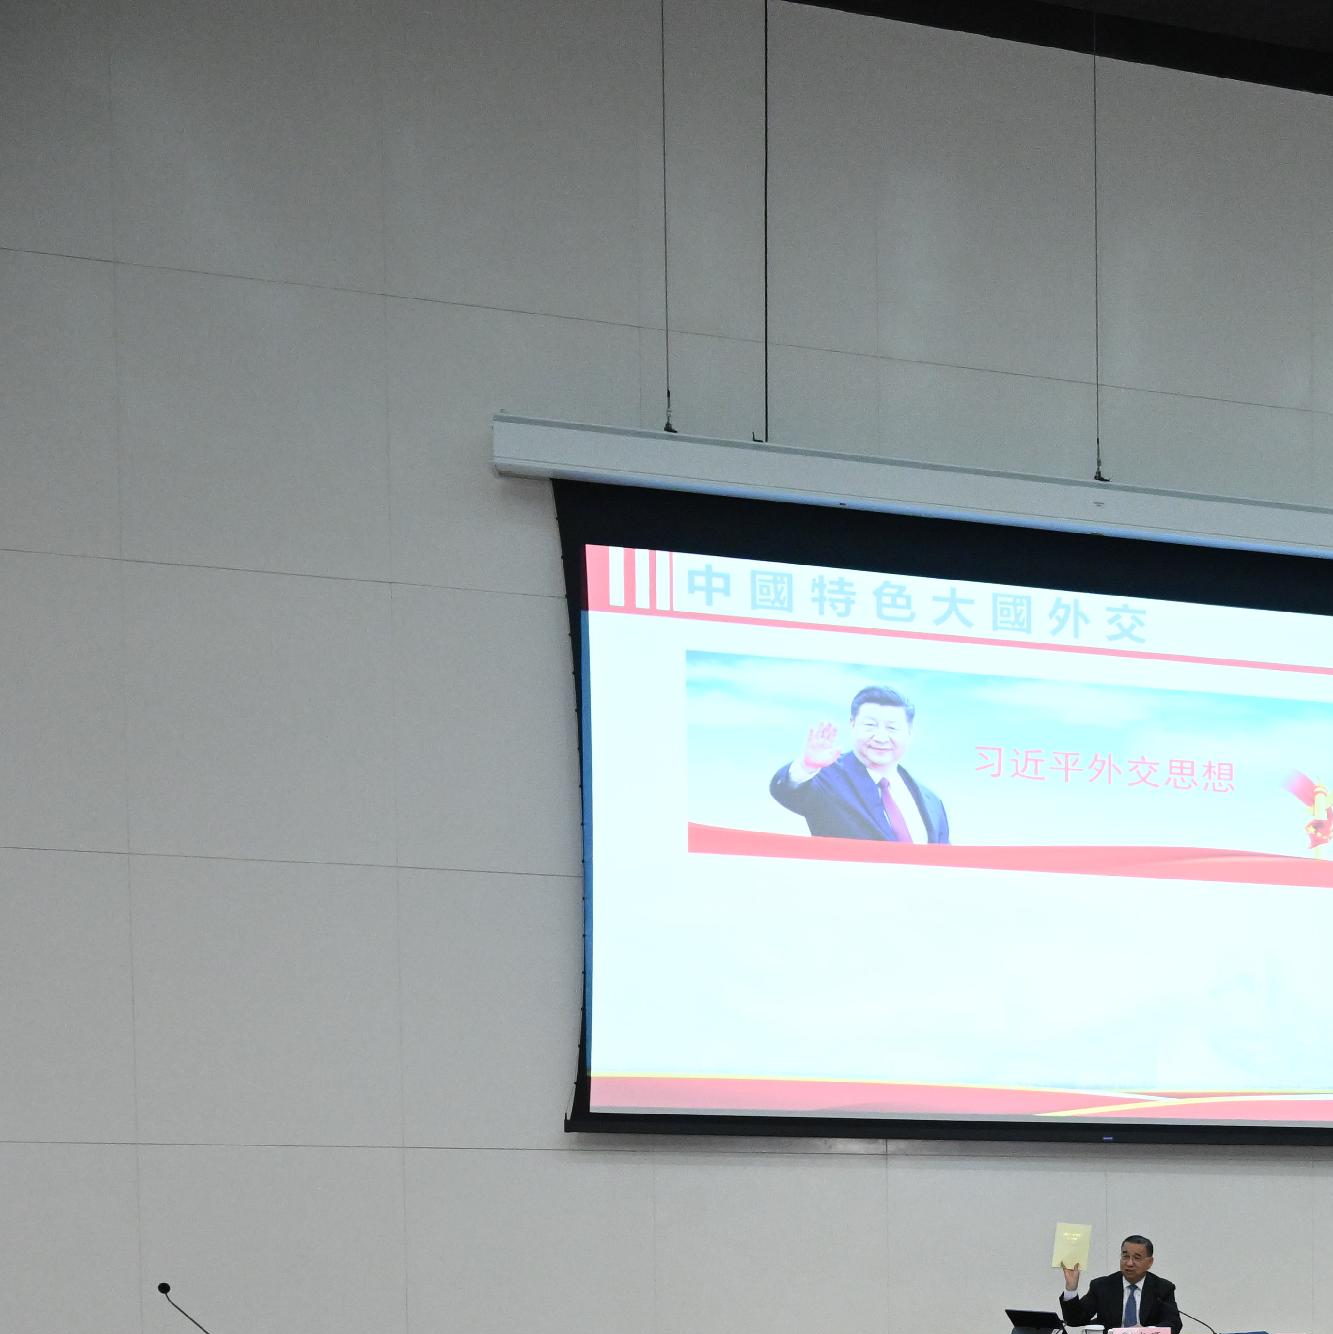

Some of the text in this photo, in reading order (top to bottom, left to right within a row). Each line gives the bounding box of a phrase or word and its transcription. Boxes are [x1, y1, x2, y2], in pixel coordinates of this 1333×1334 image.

[687, 563, 1147, 643] 中國特色大國外交
[976, 746, 1235, 793] 习近平外交思想
